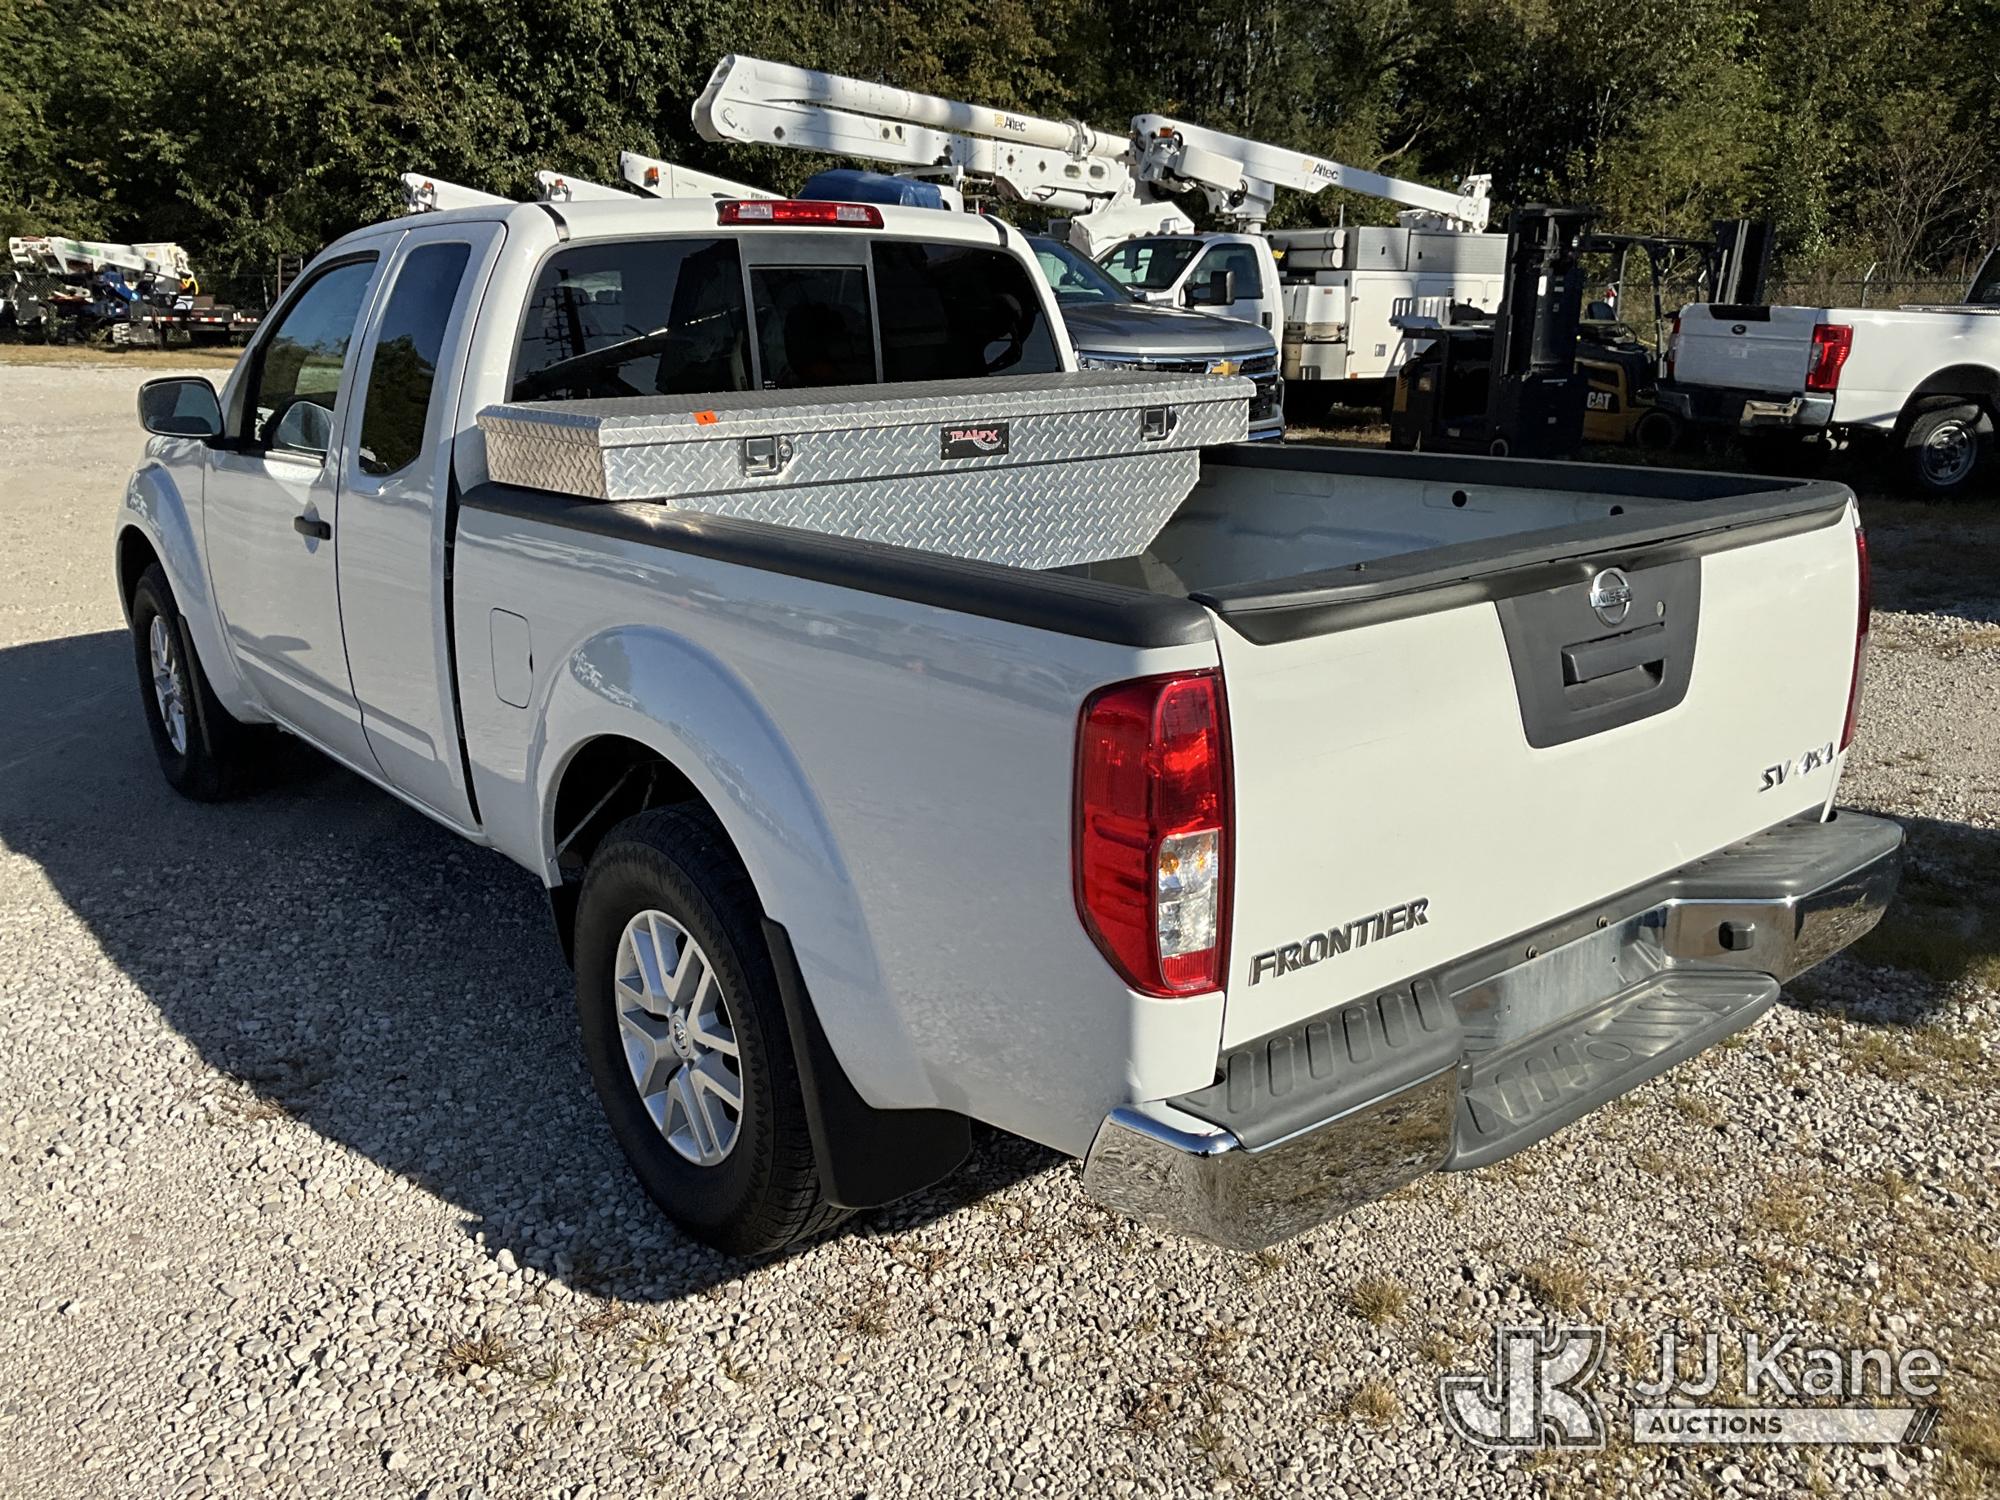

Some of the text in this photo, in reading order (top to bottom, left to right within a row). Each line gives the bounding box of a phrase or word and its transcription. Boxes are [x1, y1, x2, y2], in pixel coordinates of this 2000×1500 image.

[1313, 163, 1339, 180] Altec
[1586, 391, 1612, 410] CAT
[1757, 759, 1791, 793] SV
[1248, 897, 1429, 986] FRONTIER
